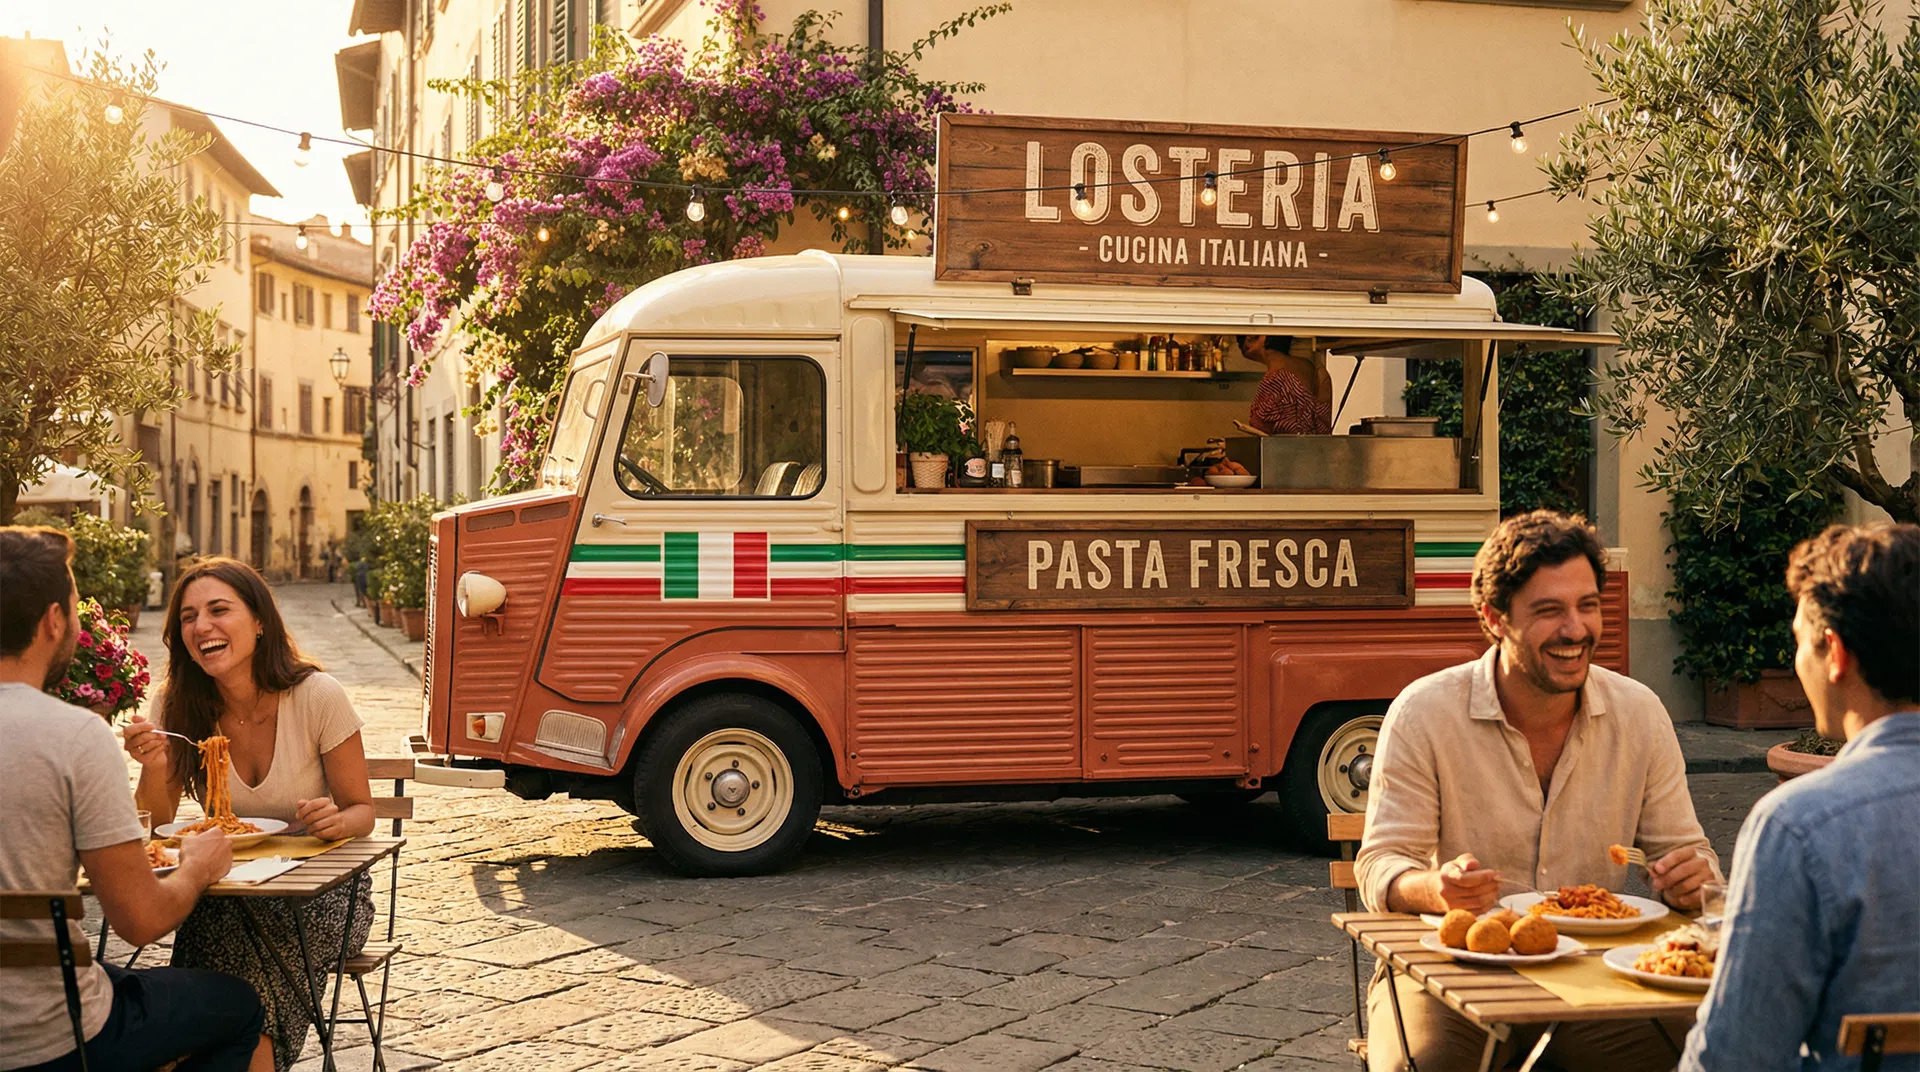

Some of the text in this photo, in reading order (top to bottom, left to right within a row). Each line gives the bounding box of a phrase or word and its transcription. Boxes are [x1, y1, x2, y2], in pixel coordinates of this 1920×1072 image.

[1026, 140, 1381, 232] LOSTERIA
[1099, 235, 1189, 265] CUCINA
[1200, 239, 1308, 268] ITALIANA
[1028, 538, 1358, 590] PASTA FRESCA
